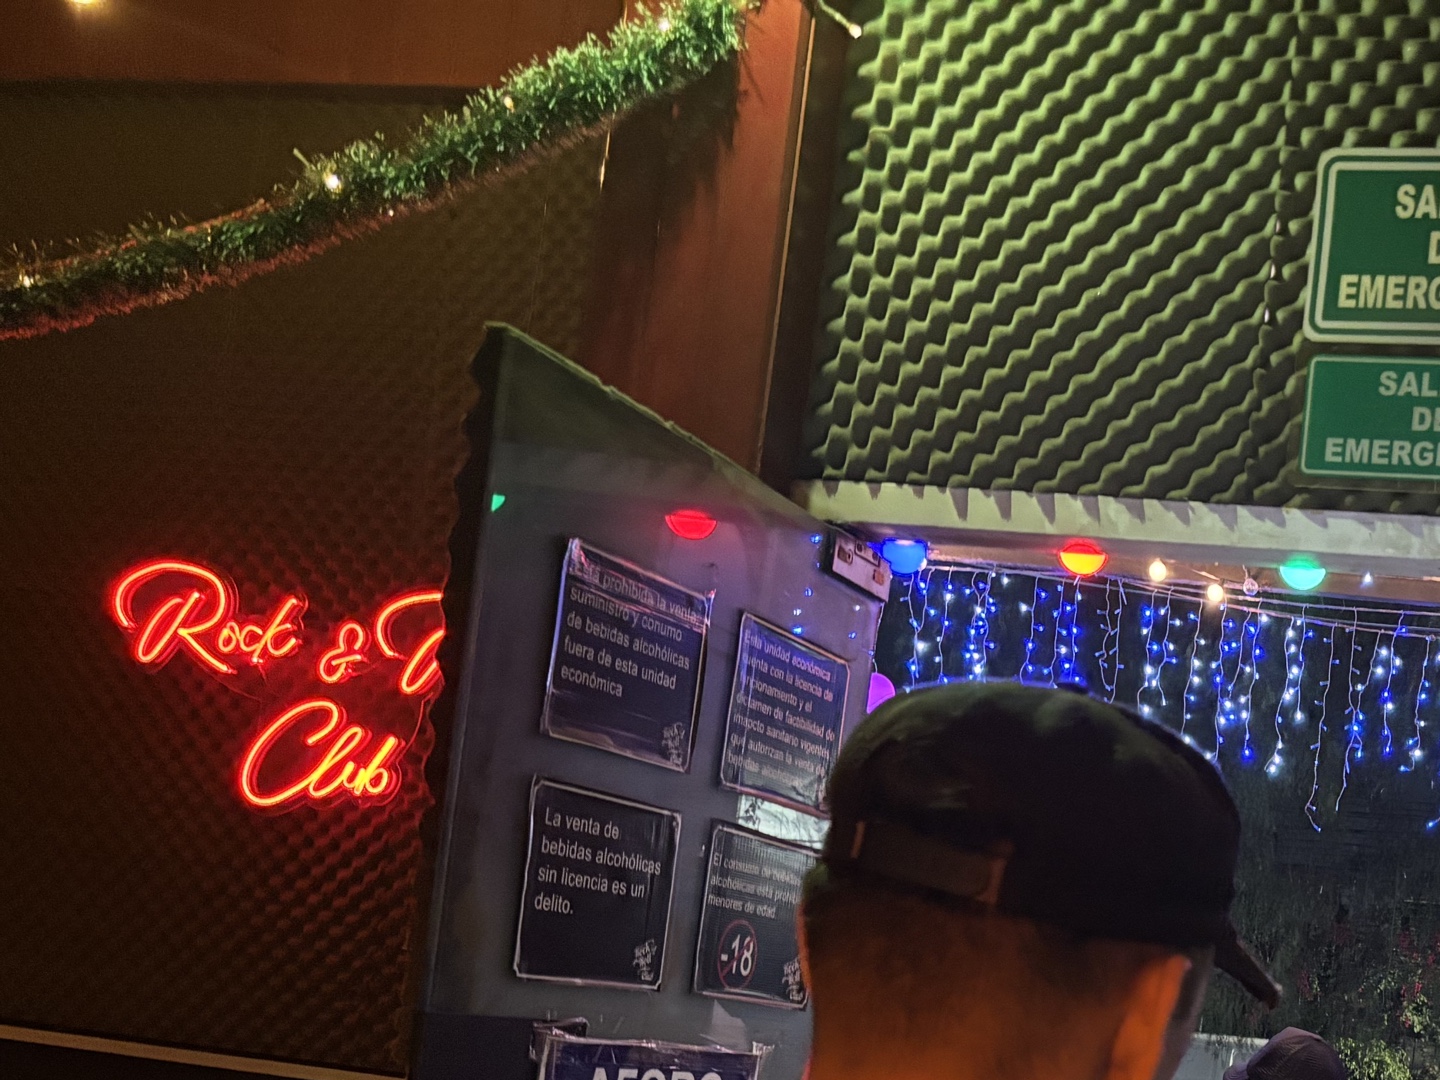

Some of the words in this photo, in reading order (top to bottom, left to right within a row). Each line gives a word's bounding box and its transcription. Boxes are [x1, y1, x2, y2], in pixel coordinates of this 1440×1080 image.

[570, 587, 629, 619] suministro
[632, 611, 640, 628] y
[641, 616, 682, 642] conumo
[656, 593, 667, 611] la
[114, 561, 301, 675] Rock
[319, 620, 366, 683] &
[567, 611, 582, 629] de
[585, 617, 630, 648] bebidas
[632, 636, 690, 670] alcohólicas
[764, 640, 791, 663] unidad
[564, 638, 594, 661] fuera
[597, 648, 612, 667] de
[615, 658, 638, 677] esta
[641, 667, 676, 690] unidad
[561, 665, 623, 697] económica
[770, 666, 785, 680] con
[795, 676, 823, 697] licencia
[241, 699, 398, 807] Club
[545, 807, 561, 827] La
[566, 816, 600, 836] venta
[604, 821, 620, 840] de
[541, 835, 592, 862] bebidas
[595, 847, 661, 875] alcohólicas
[538, 866, 557, 883] sin
[561, 868, 608, 892] licencia
[612, 880, 627, 895] es
[630, 884, 645, 899] un
[534, 892, 574, 915] delito.
[708, 895, 743, 912] menores
[744, 900, 755, 915] de
